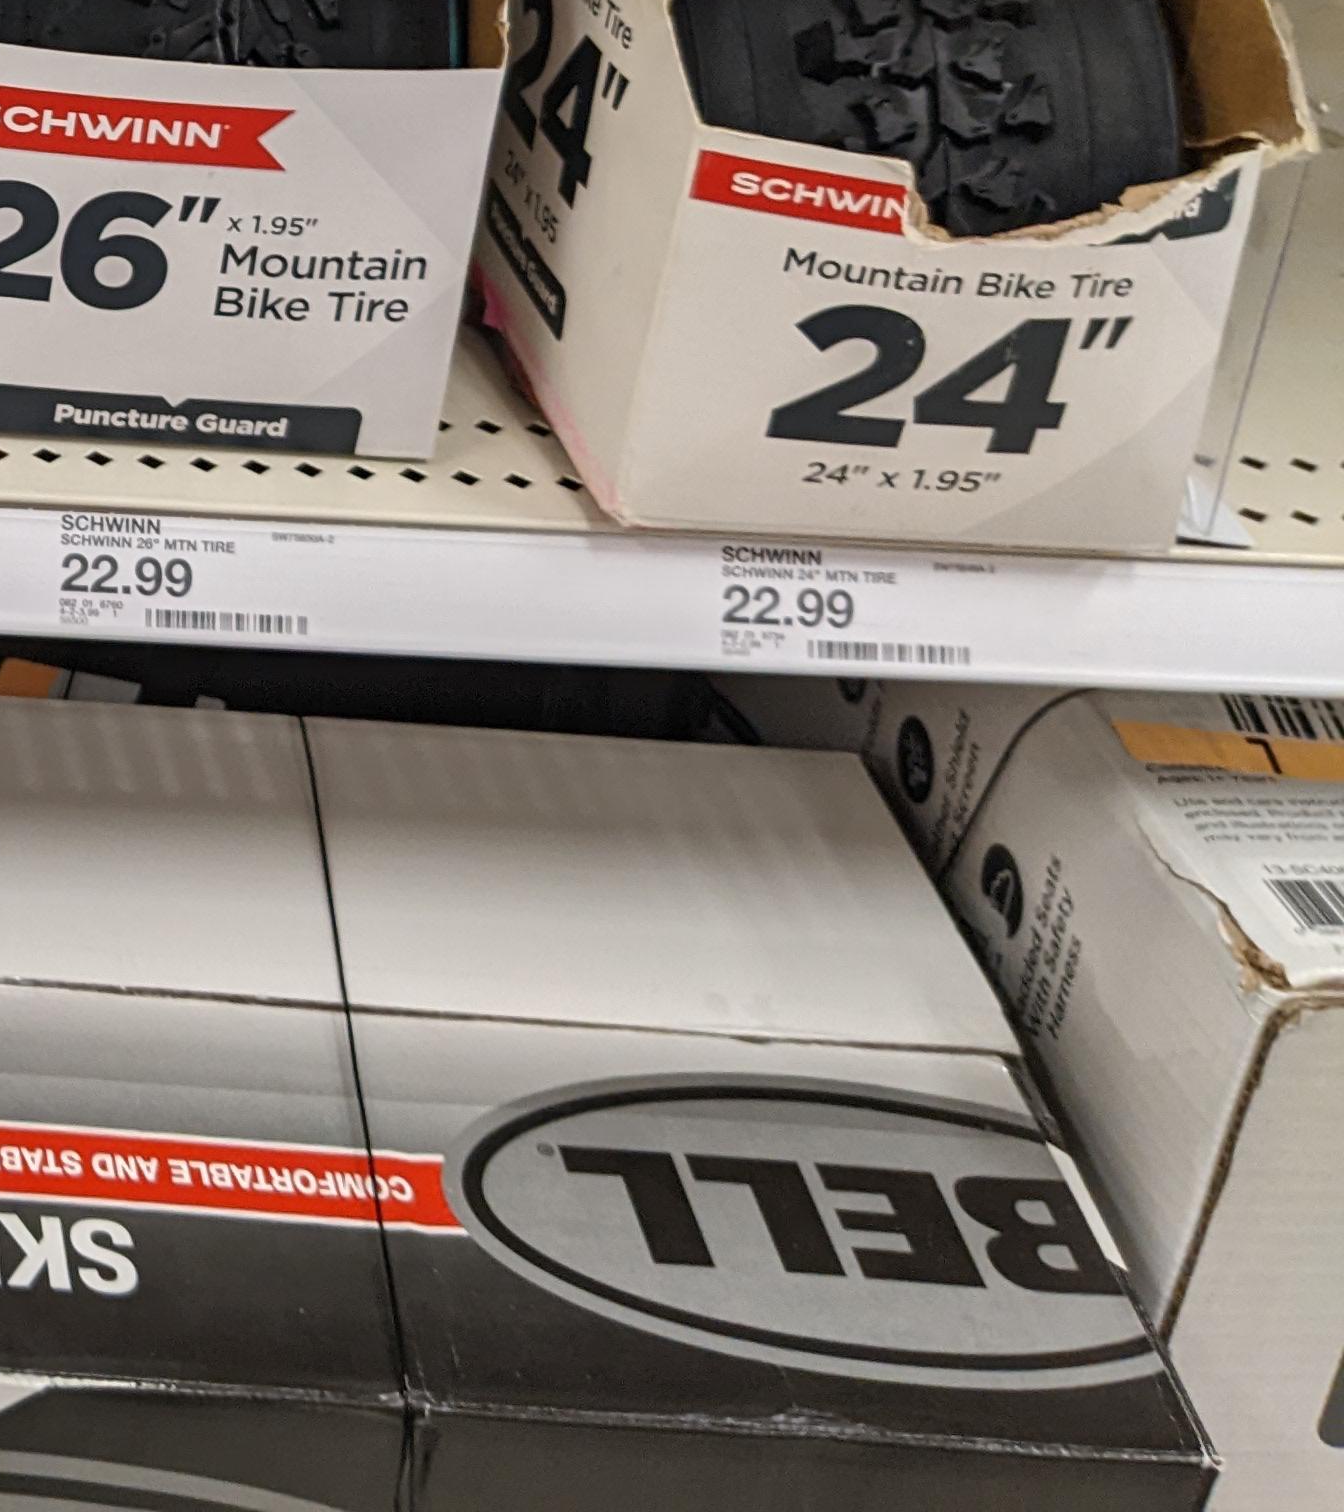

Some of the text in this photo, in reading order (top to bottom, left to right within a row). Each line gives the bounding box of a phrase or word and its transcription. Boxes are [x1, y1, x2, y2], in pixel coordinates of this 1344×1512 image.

[729, 170, 910, 223] SCHWIN
[226, 217, 243, 233] x
[218, 243, 429, 283] Mountain
[782, 246, 1135, 301] Mountain Bike Tire
[212, 288, 410, 326] Bike Tire
[52, 403, 291, 439] Puncture Guard
[879, 469, 900, 490] x
[61, 514, 161, 536] SCHWINN
[60, 552, 194, 598] 22.99
[721, 545, 822, 566] SCHWINN
[721, 584, 854, 629] 22.99
[96, 1153, 159, 1183] AND
[171, 1157, 415, 1204] COMFORTABLE
[558, 1141, 1128, 1297] BELL
